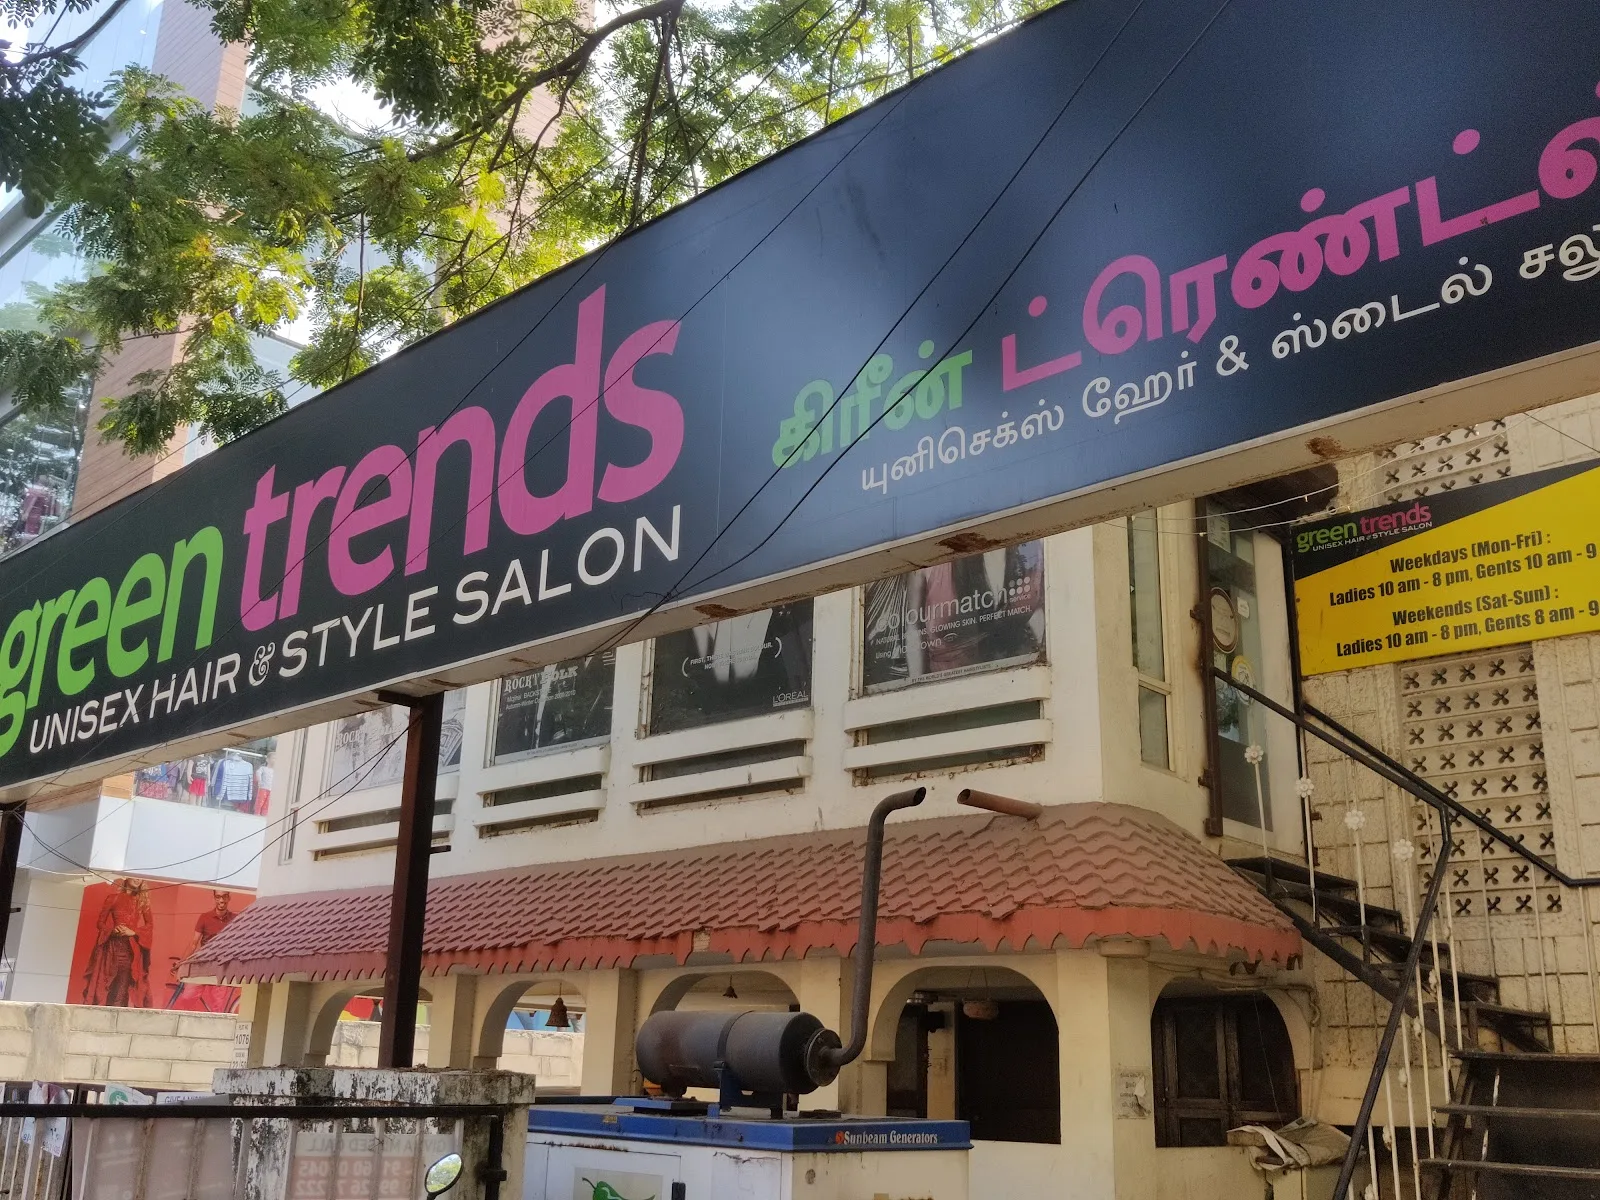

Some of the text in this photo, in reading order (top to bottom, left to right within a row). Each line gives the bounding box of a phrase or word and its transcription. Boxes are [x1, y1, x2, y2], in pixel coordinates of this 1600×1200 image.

[1215, 334, 1250, 377] &
[770, 340, 974, 469] கிரீன்
[0, 287, 685, 758] green trends
[1296, 502, 1432, 553] green trends
[1312, 540, 1343, 552] UNISEX
[1344, 534, 1365, 545] HAIR
[1372, 528, 1400, 539] STYLE
[1401, 521, 1433, 533] SALON
[1389, 546, 1468, 573] Weekdays
[1471, 530, 1543, 558] (Mon-Fri)
[1329, 586, 1375, 606] Ladies
[1377, 580, 1395, 597] 10
[1397, 577, 1421, 595] am
[1432, 571, 1442, 587] 8
[1445, 573, 1473, 586] pm,
[1476, 558, 1522, 578] Gents
[1524, 552, 1543, 570] 10
[1546, 548, 1573, 566] am
[1585, 542, 1598, 559] 9
[875, 587, 1008, 632] colourmatch
[929, 619, 961, 634] GLOWING
[961, 616, 978, 628] SKIN.
[979, 609, 1007, 623] PERFECT
[1007, 604, 1034, 617] MATCH.
[1392, 599, 1473, 626] Weekends
[1476, 585, 1551, 611] (Sat-Sun)
[29, 504, 681, 754] UNISEX HAIR & STYLE SALON
[1336, 635, 1383, 657] Ladies
[1385, 633, 1402, 649] 10
[1404, 630, 1429, 647] am
[1440, 624, 1451, 640] 8
[1453, 621, 1482, 640] pm,
[1485, 613, 1532, 633] Gents
[1534, 608, 1546, 625] 8
[1549, 604, 1576, 622] am
[1588, 599, 1600, 616] 9
[235, 1033, 250, 1045] 1076
[844, 1130, 938, 1145] Sunbeam Generators
